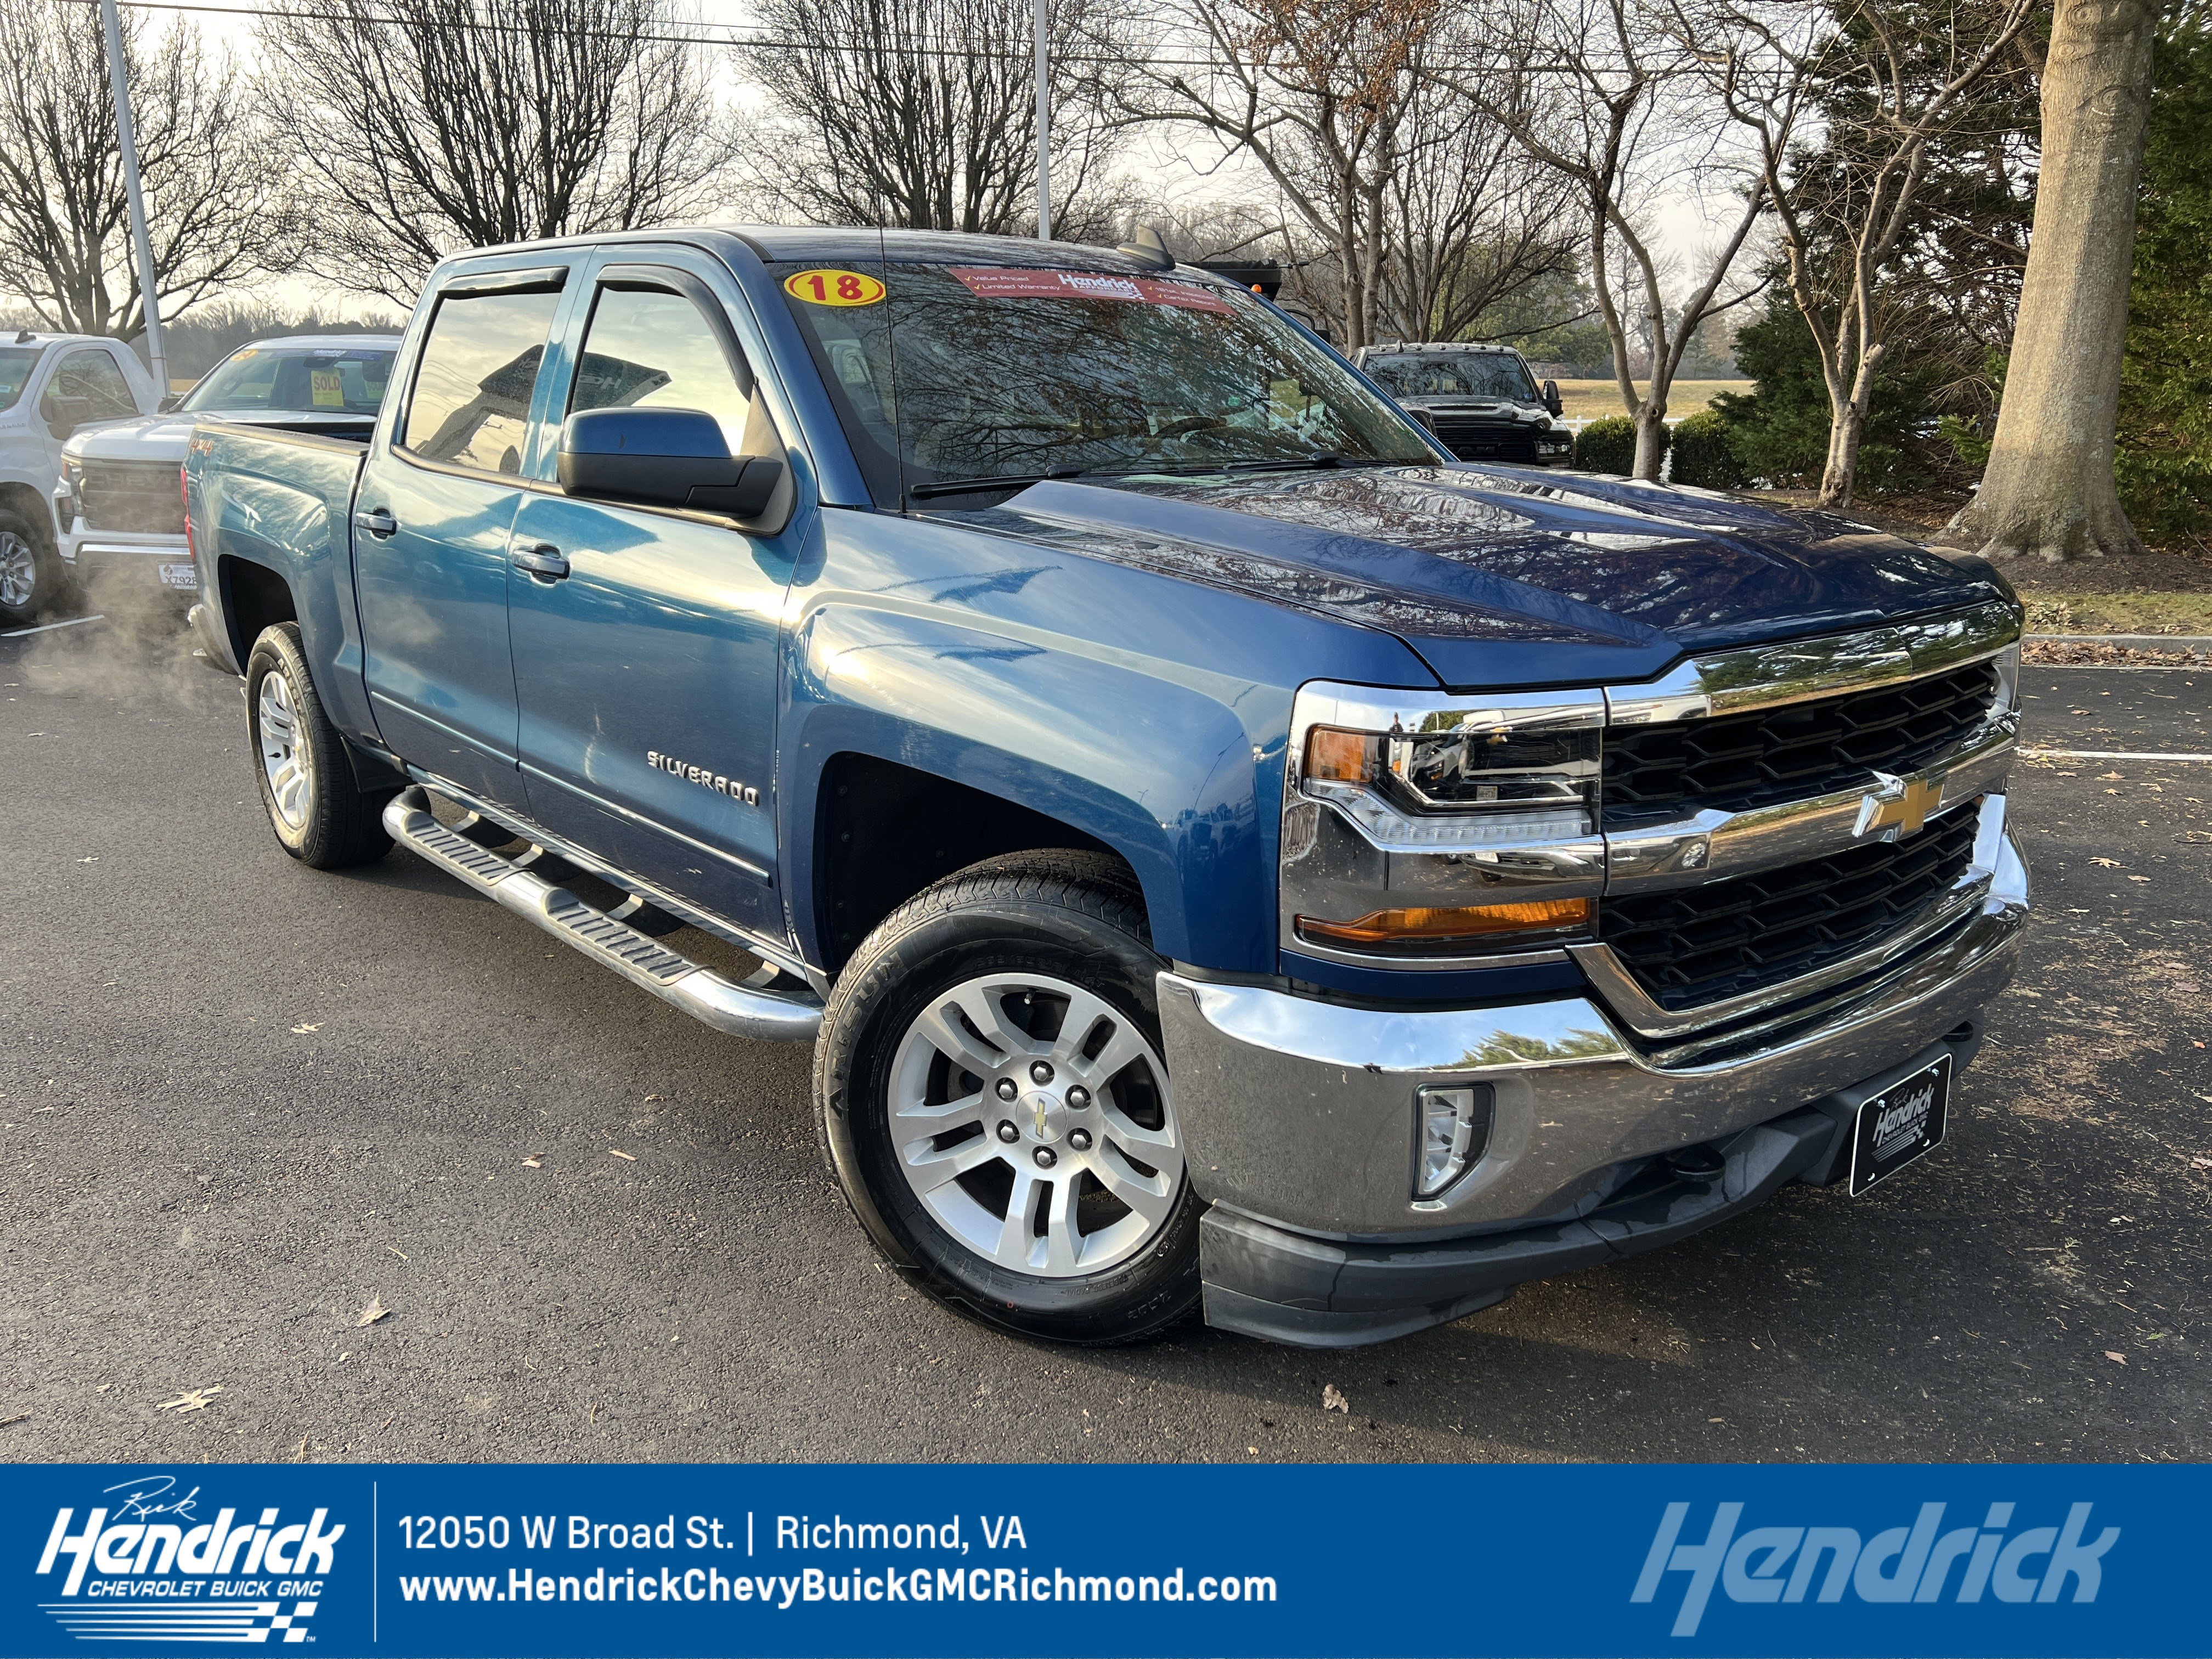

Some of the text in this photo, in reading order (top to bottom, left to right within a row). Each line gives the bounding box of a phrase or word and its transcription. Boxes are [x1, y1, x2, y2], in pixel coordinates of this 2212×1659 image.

[807, 274, 863, 301] 18
[1058, 274, 1138, 290] Hendrick
[313, 376, 340, 391] SOLD
[647, 751, 760, 806] SILVERADO
[828, 951, 905, 1121] ARISUN
[1872, 1083, 1935, 1147] Hendrick
